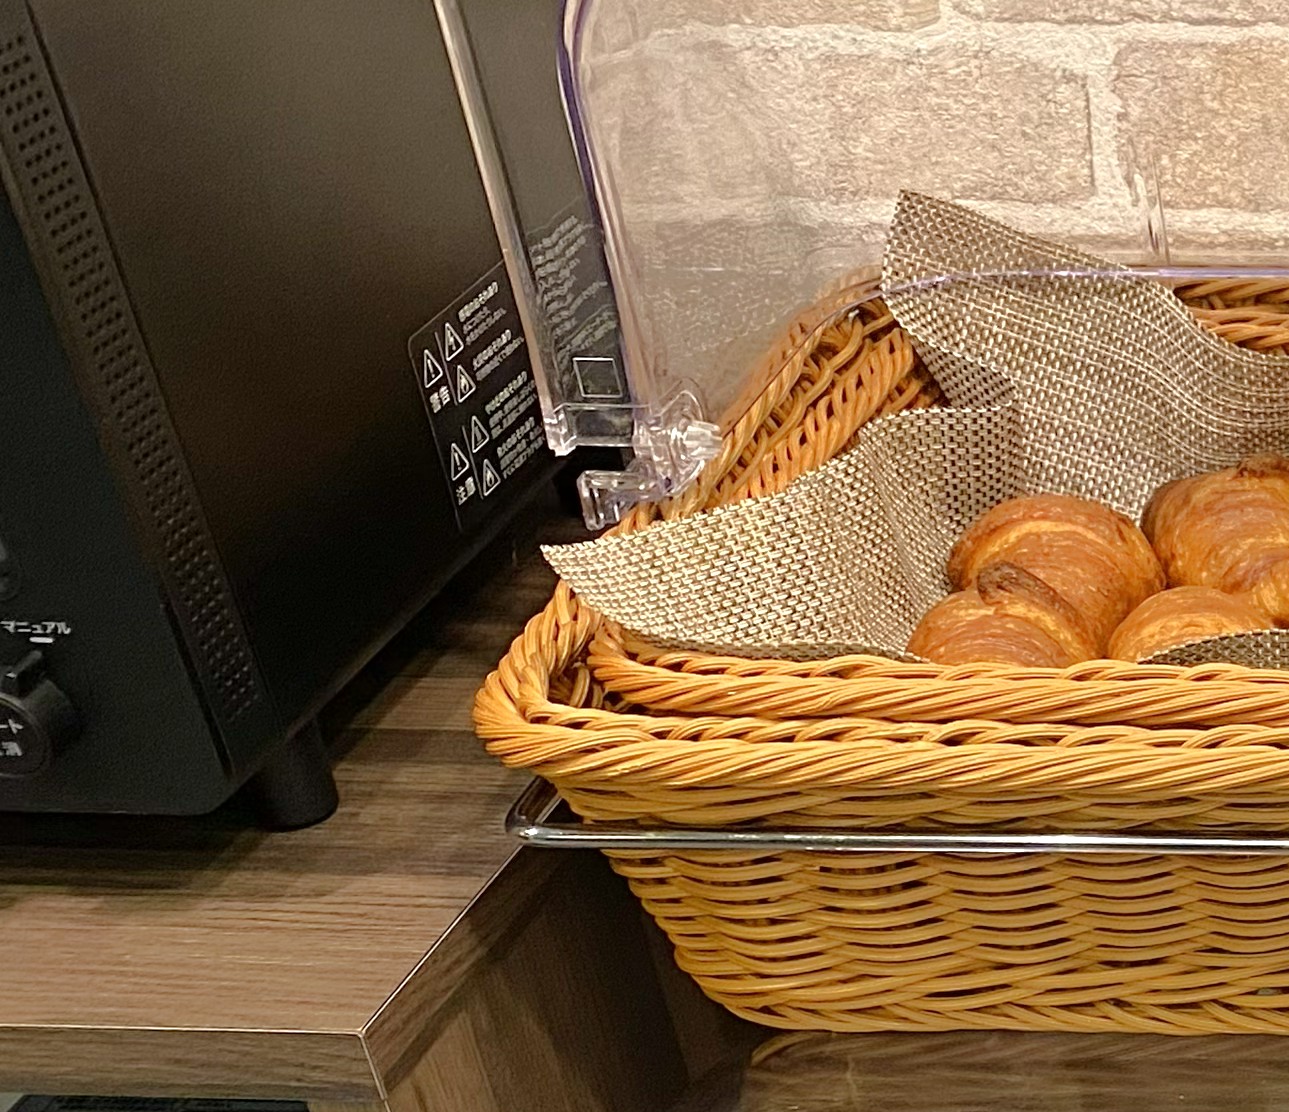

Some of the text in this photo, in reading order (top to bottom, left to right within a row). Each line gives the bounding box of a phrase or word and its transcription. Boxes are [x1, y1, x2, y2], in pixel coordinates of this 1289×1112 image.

[0, 619, 72, 636] マニュアル
